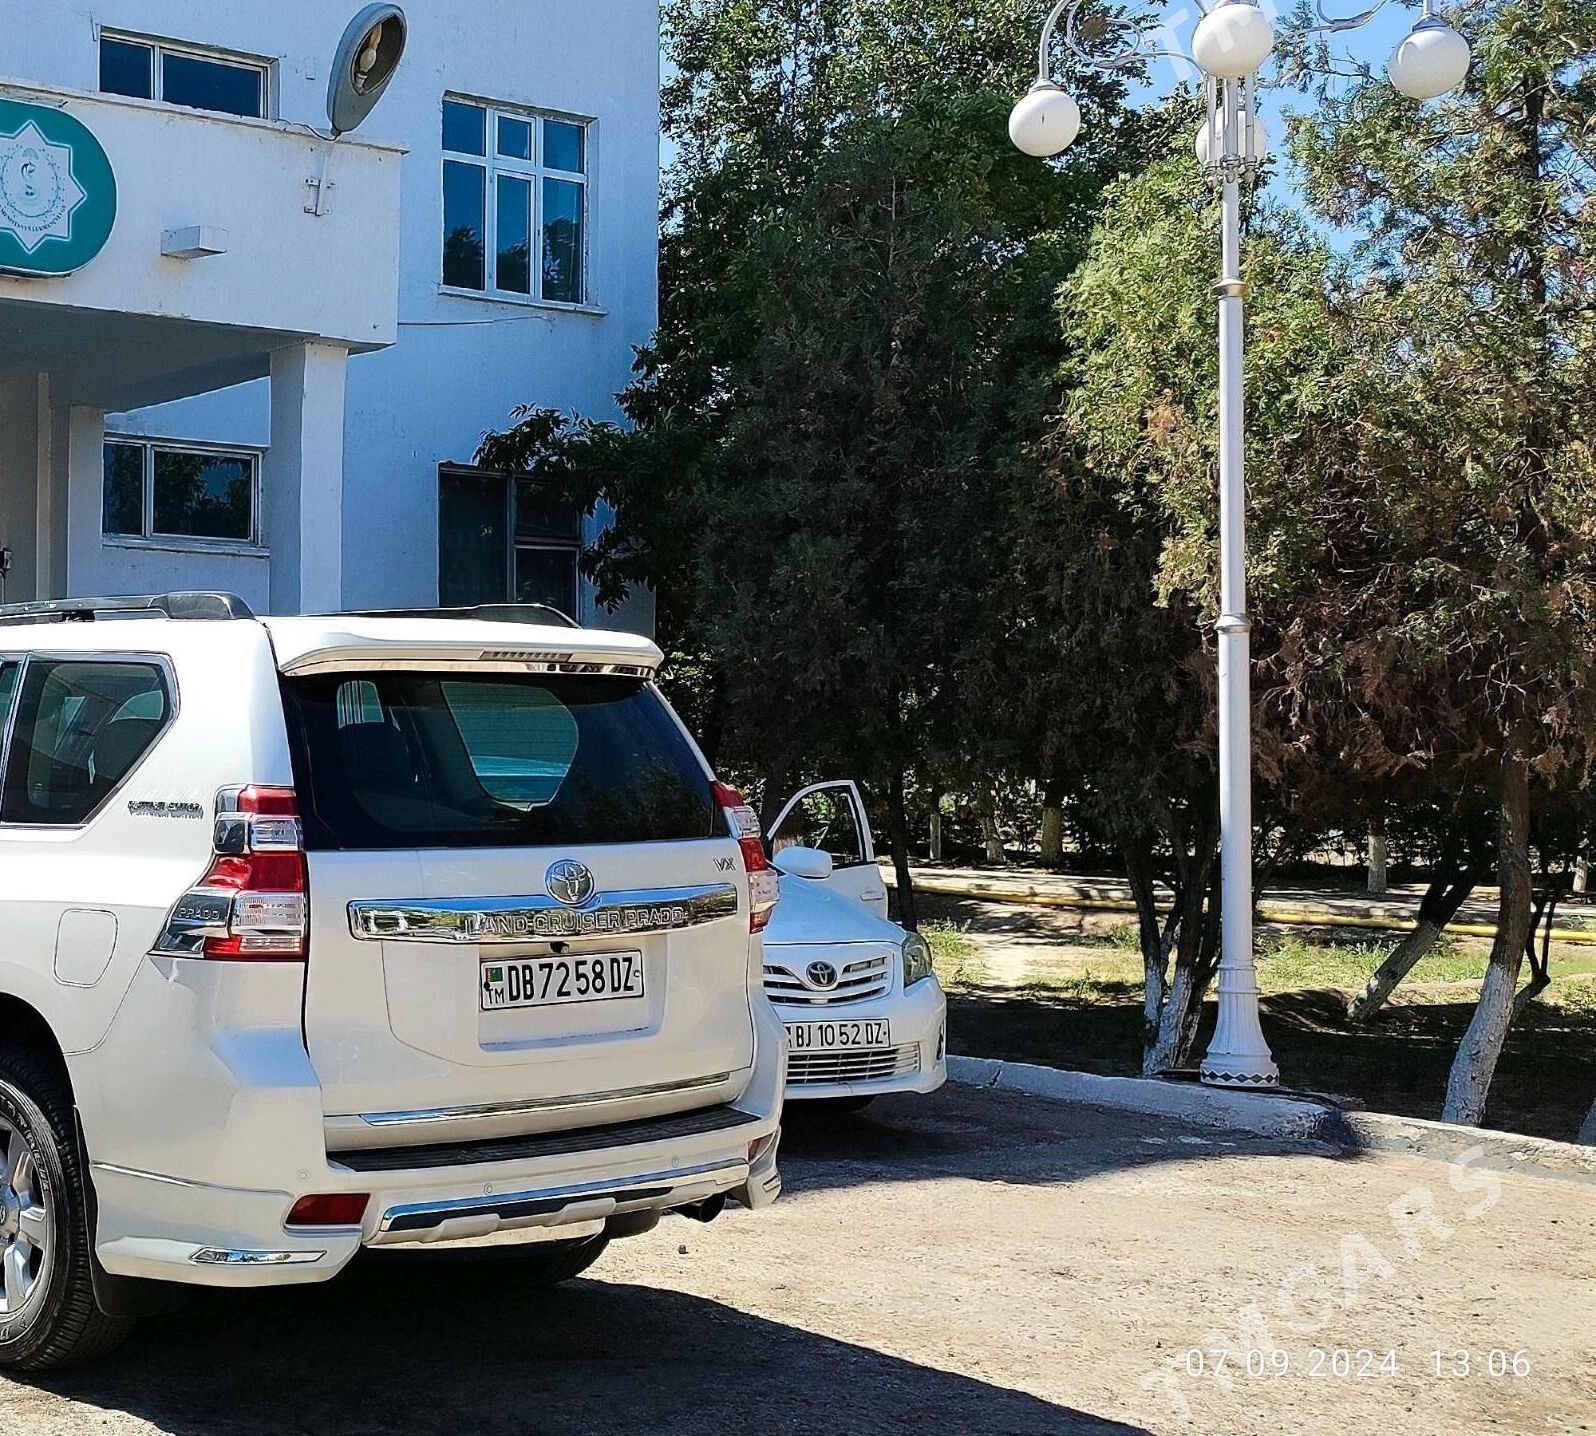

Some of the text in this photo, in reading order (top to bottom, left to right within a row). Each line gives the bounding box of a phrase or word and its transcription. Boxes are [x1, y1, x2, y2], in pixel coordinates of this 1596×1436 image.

[713, 856, 736, 871] VX
[464, 906, 685, 935] LAND CRUISER PRADO
